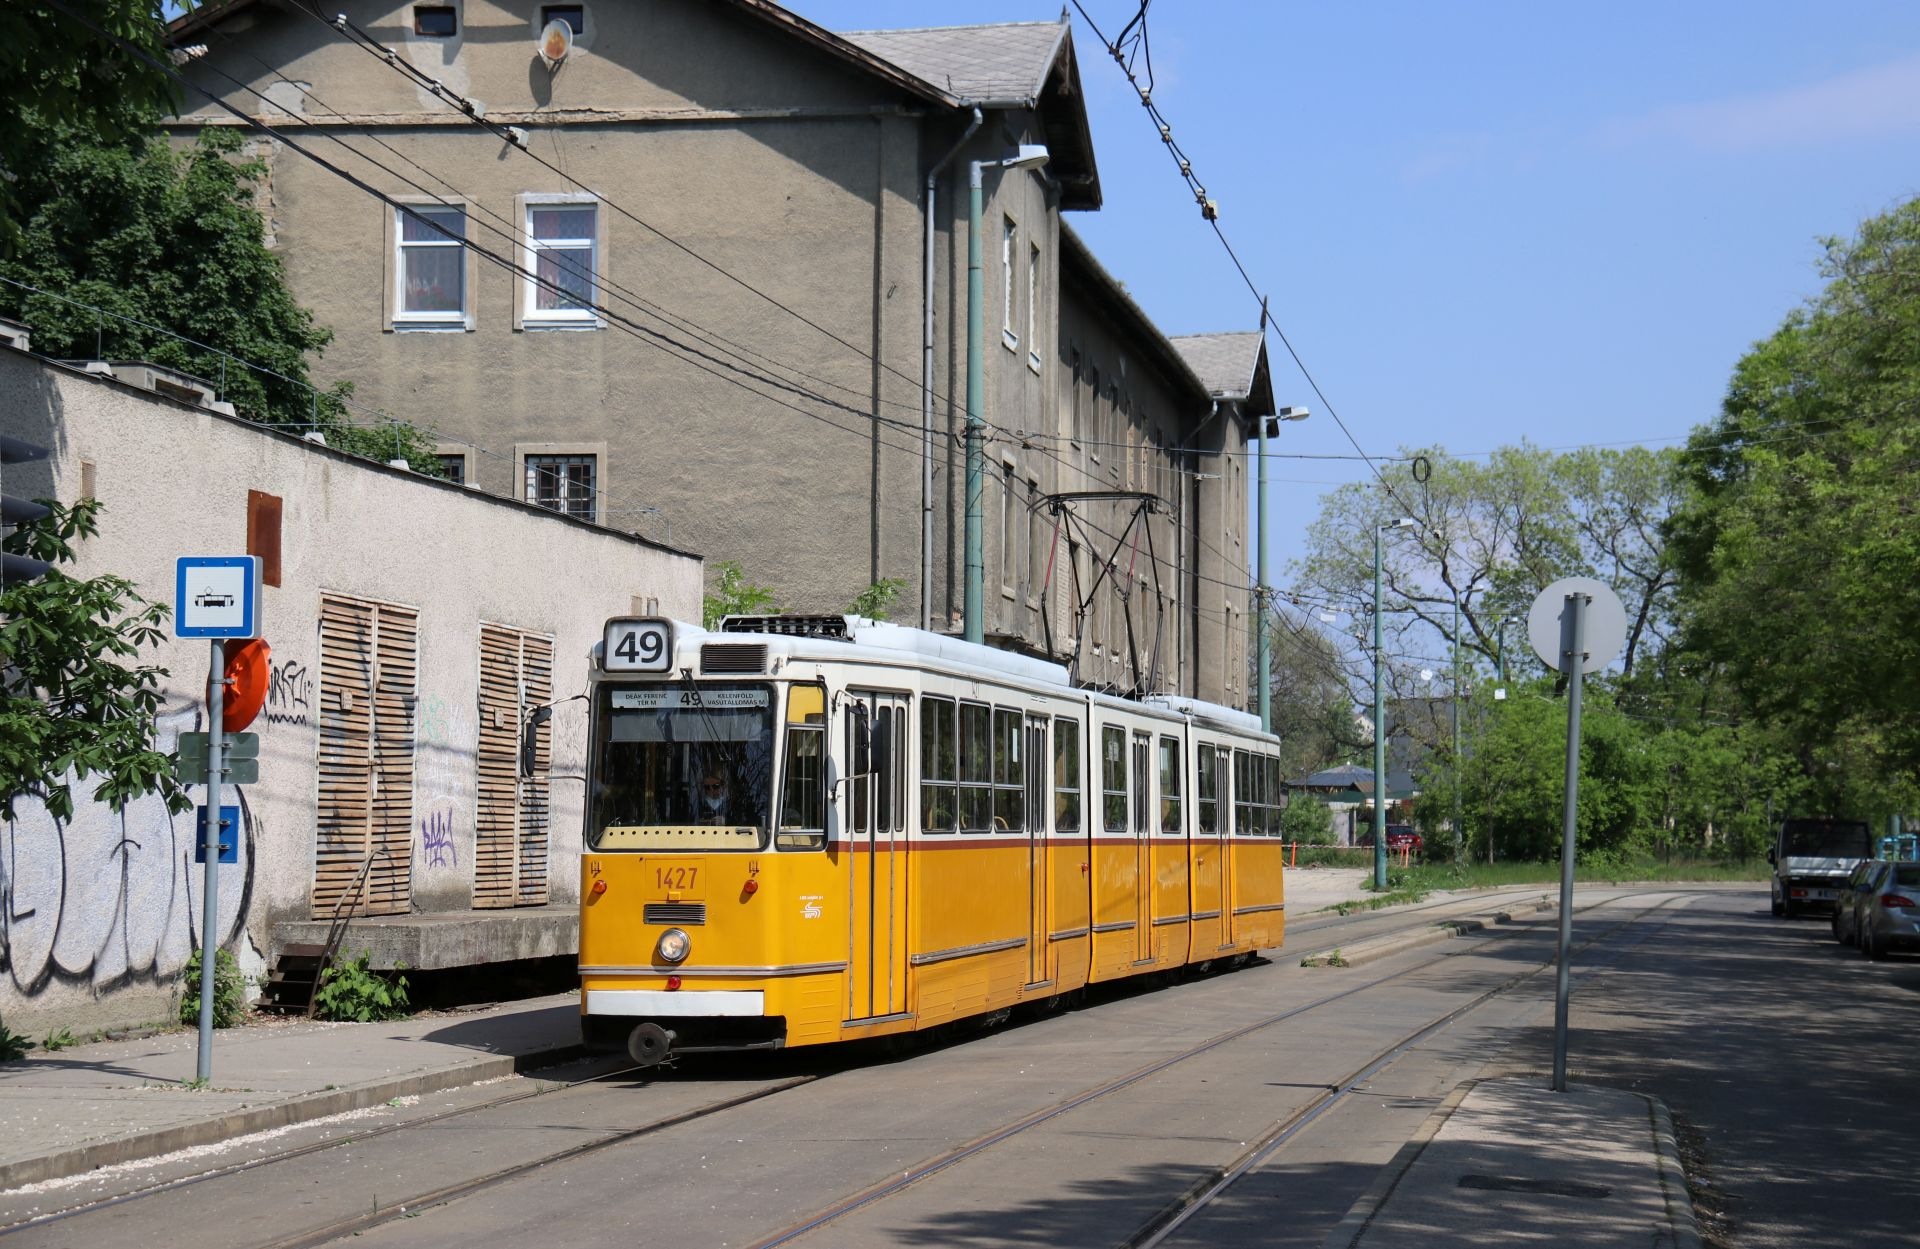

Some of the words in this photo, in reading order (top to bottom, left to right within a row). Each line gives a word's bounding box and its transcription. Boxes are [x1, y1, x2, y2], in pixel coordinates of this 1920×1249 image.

[614, 630, 664, 664] 49
[625, 692, 643, 700] DEÁK
[643, 692, 668, 700] FERENC
[680, 692, 701, 706] 49
[717, 691, 754, 699] KELENFÖLD
[656, 867, 698, 889] 1427
